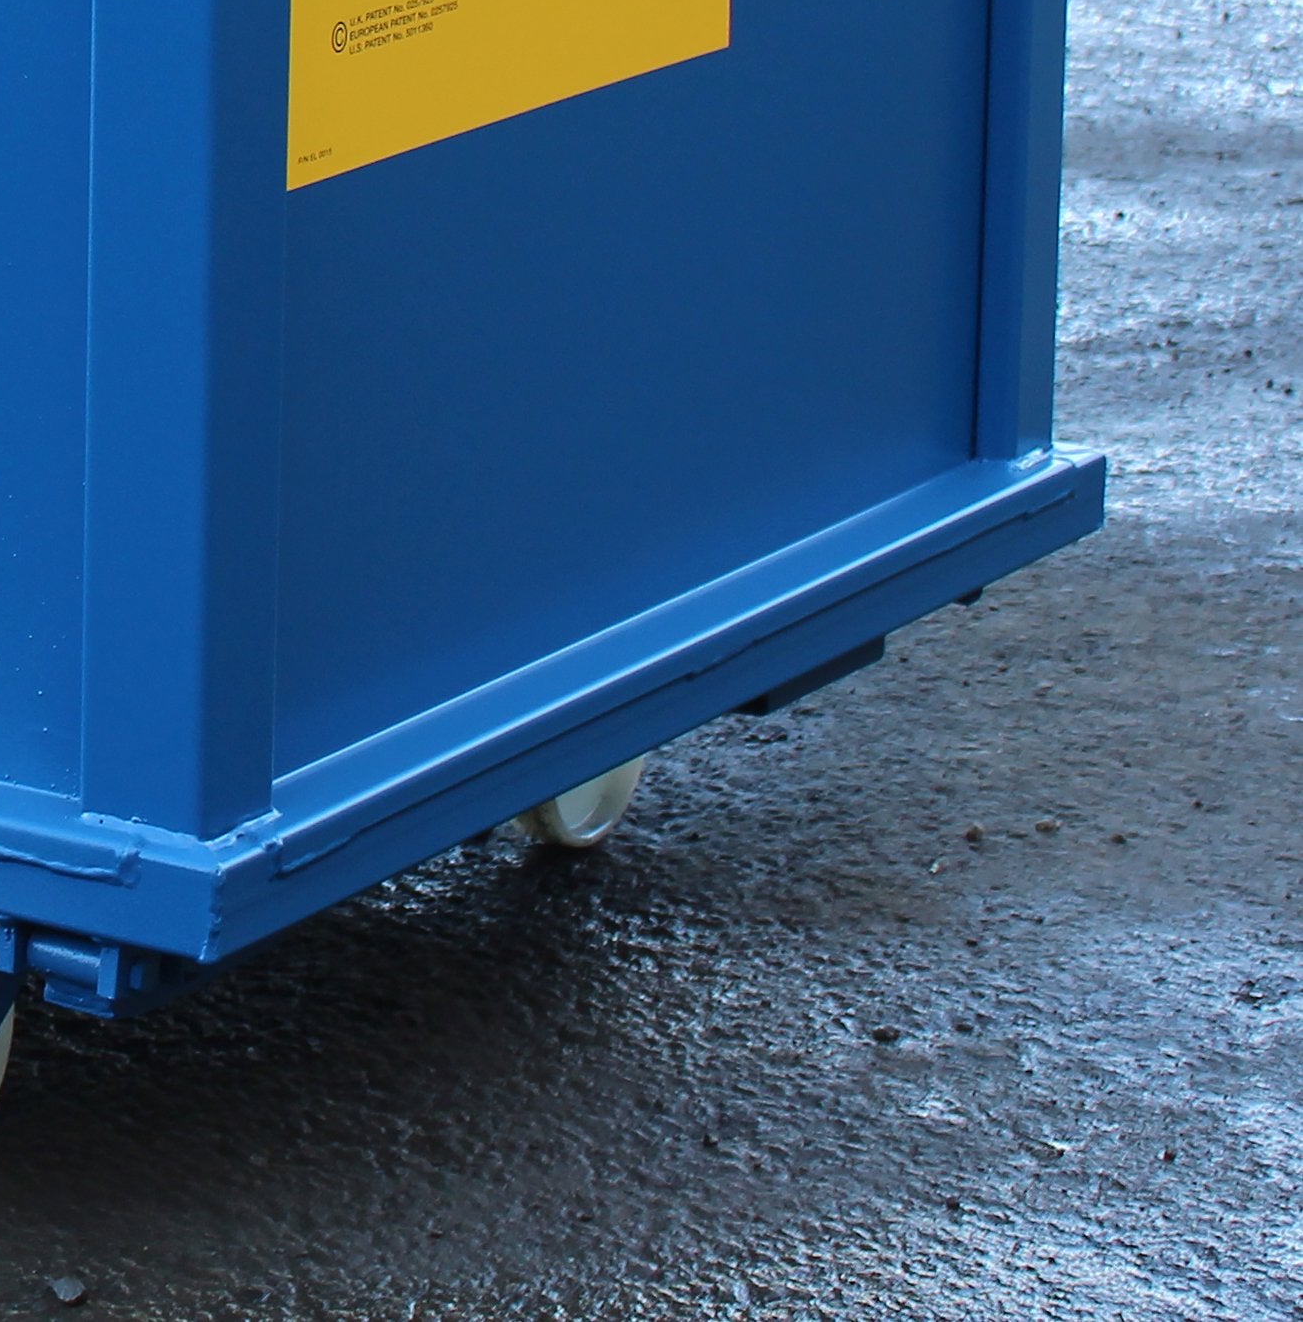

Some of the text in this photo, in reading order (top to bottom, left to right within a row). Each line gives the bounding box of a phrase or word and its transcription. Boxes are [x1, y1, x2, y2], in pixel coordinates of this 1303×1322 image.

[366, 6, 392, 20] PATENT
[349, 22, 389, 41] EUROPEAN
[390, 13, 416, 28] PATENT
[365, 34, 390, 49] PATENT
